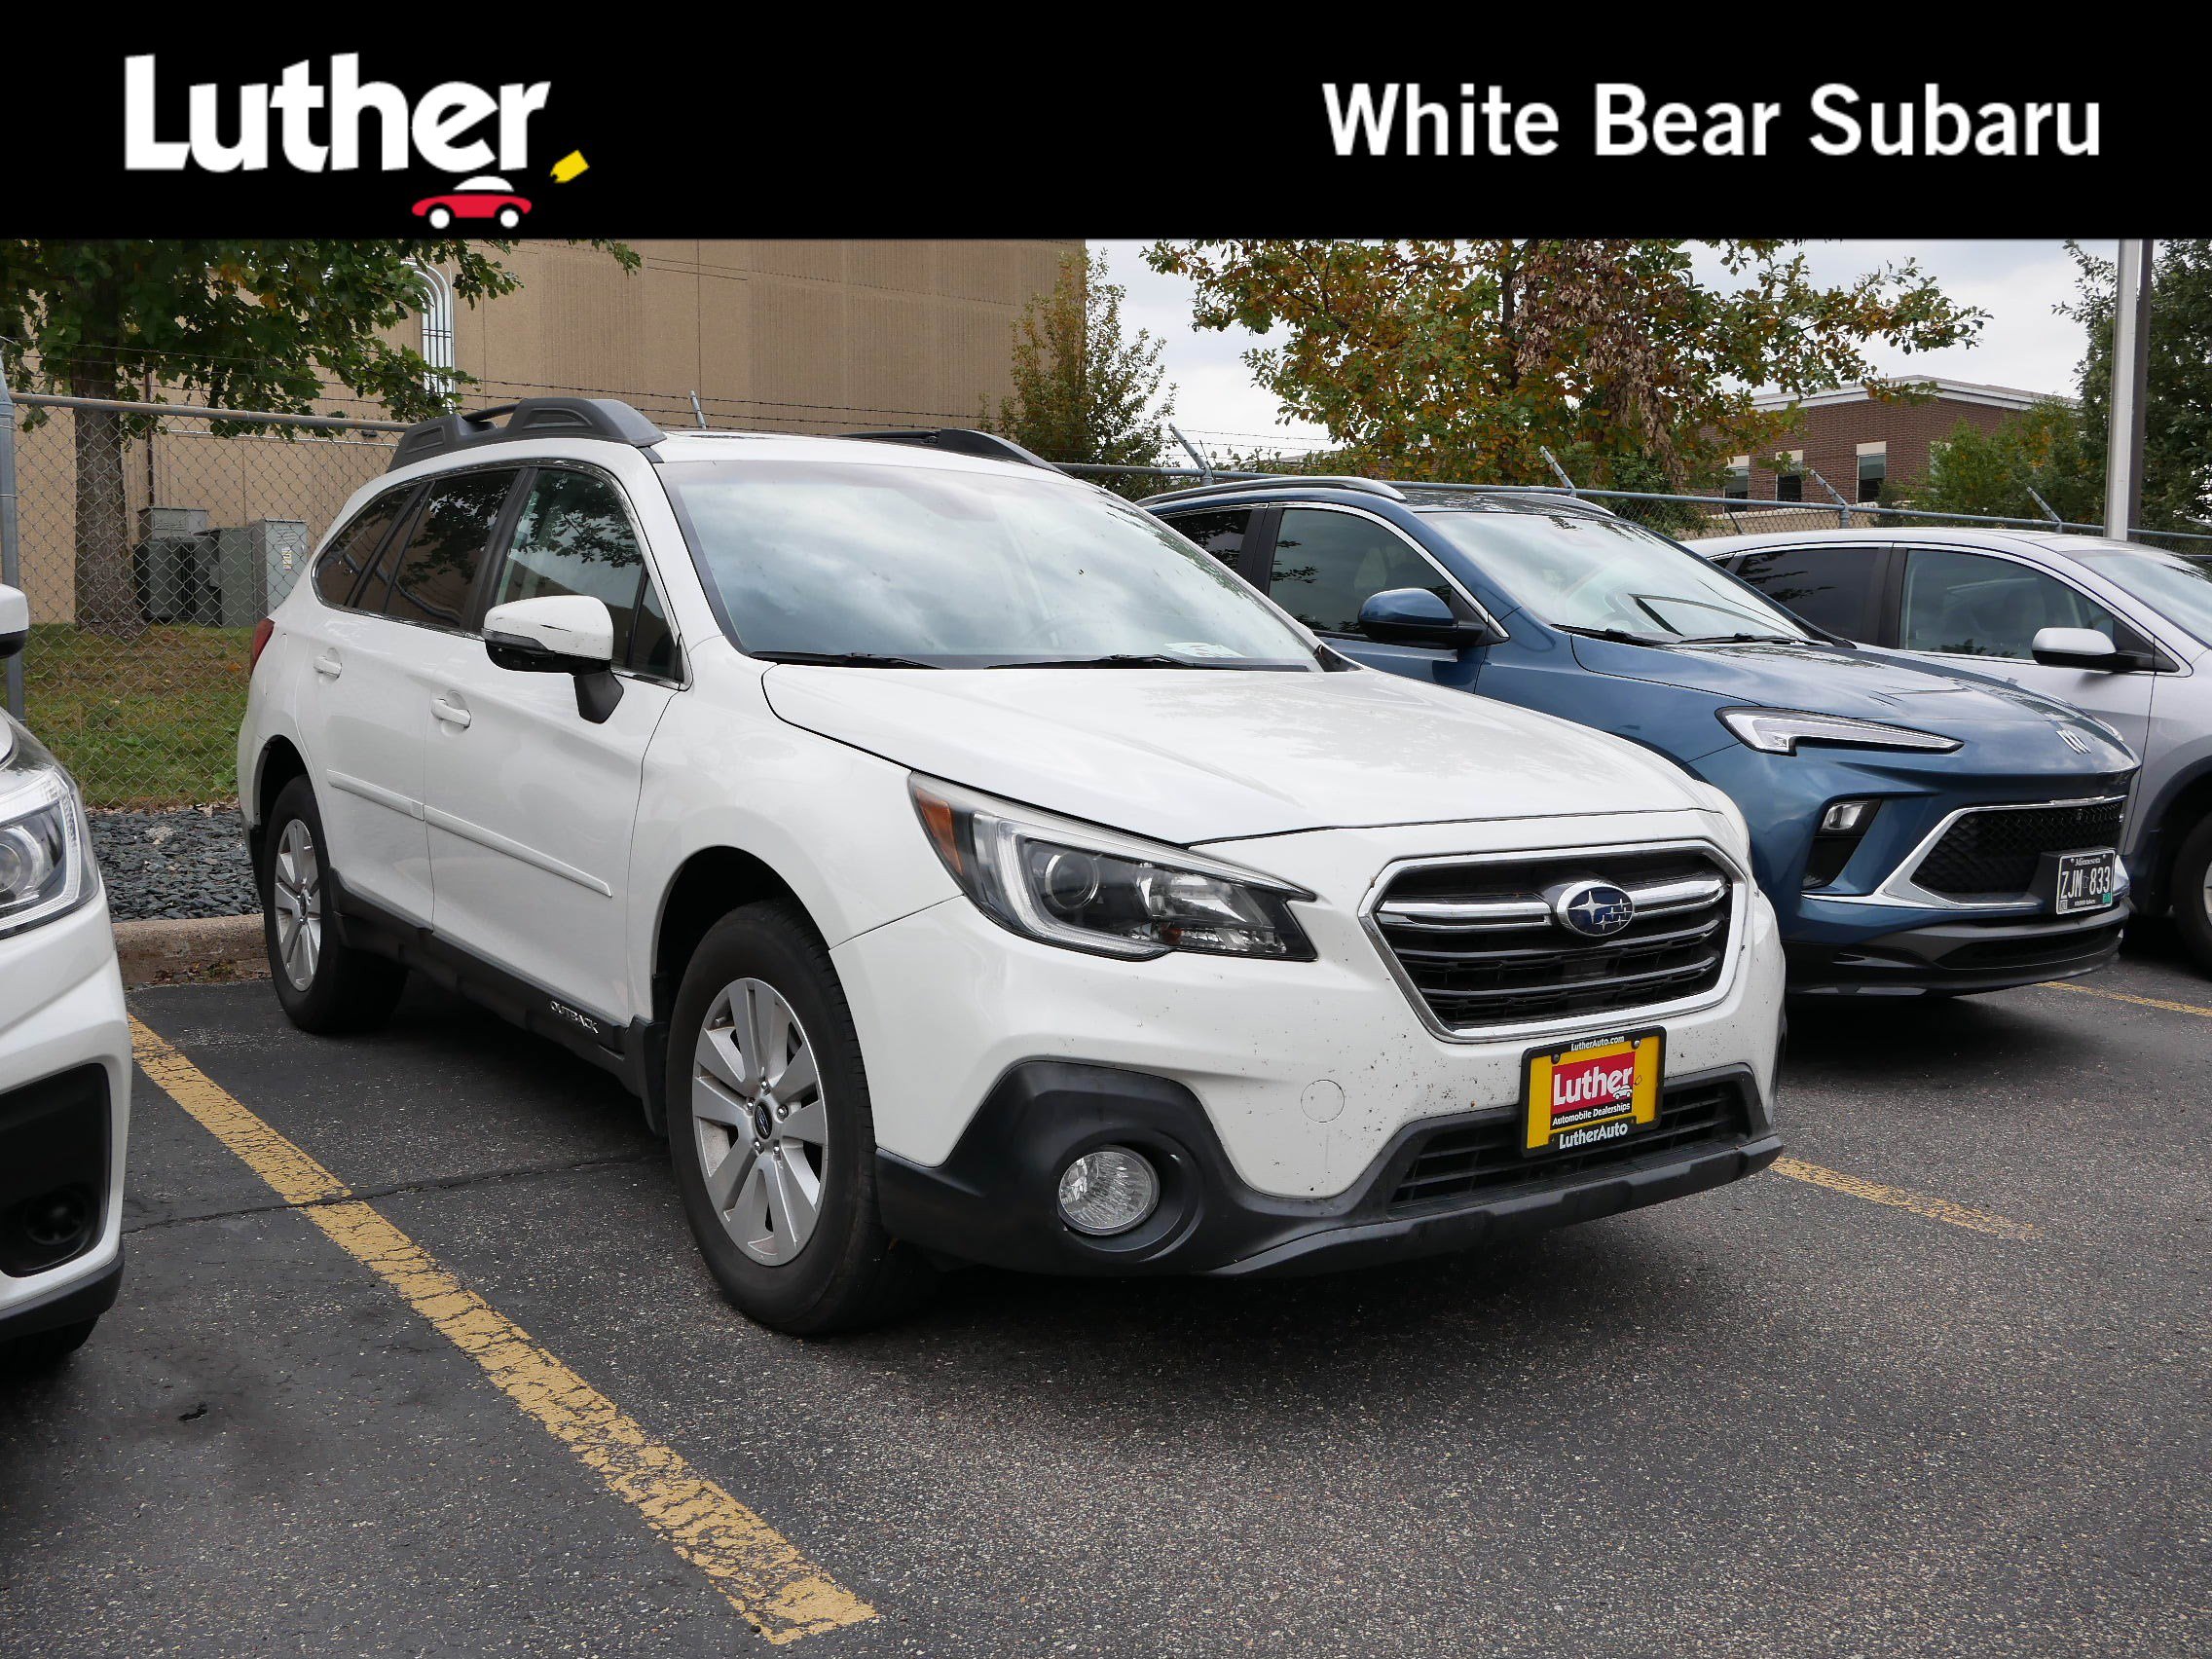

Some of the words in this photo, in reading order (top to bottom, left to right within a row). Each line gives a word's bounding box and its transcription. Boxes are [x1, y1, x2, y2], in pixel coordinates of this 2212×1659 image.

[2061, 869, 2083, 899] ZJM
[2089, 866, 2110, 895] 833
[550, 1000, 599, 1034] OUTBACK
[1570, 1035, 1625, 1051] LutherAuto.com
[1553, 1065, 1634, 1106] Luther
[1552, 1110, 1593, 1126] Automobile
[1593, 1102, 1631, 1119] Dealerships
[1559, 1123, 1628, 1149] LutherAuto
